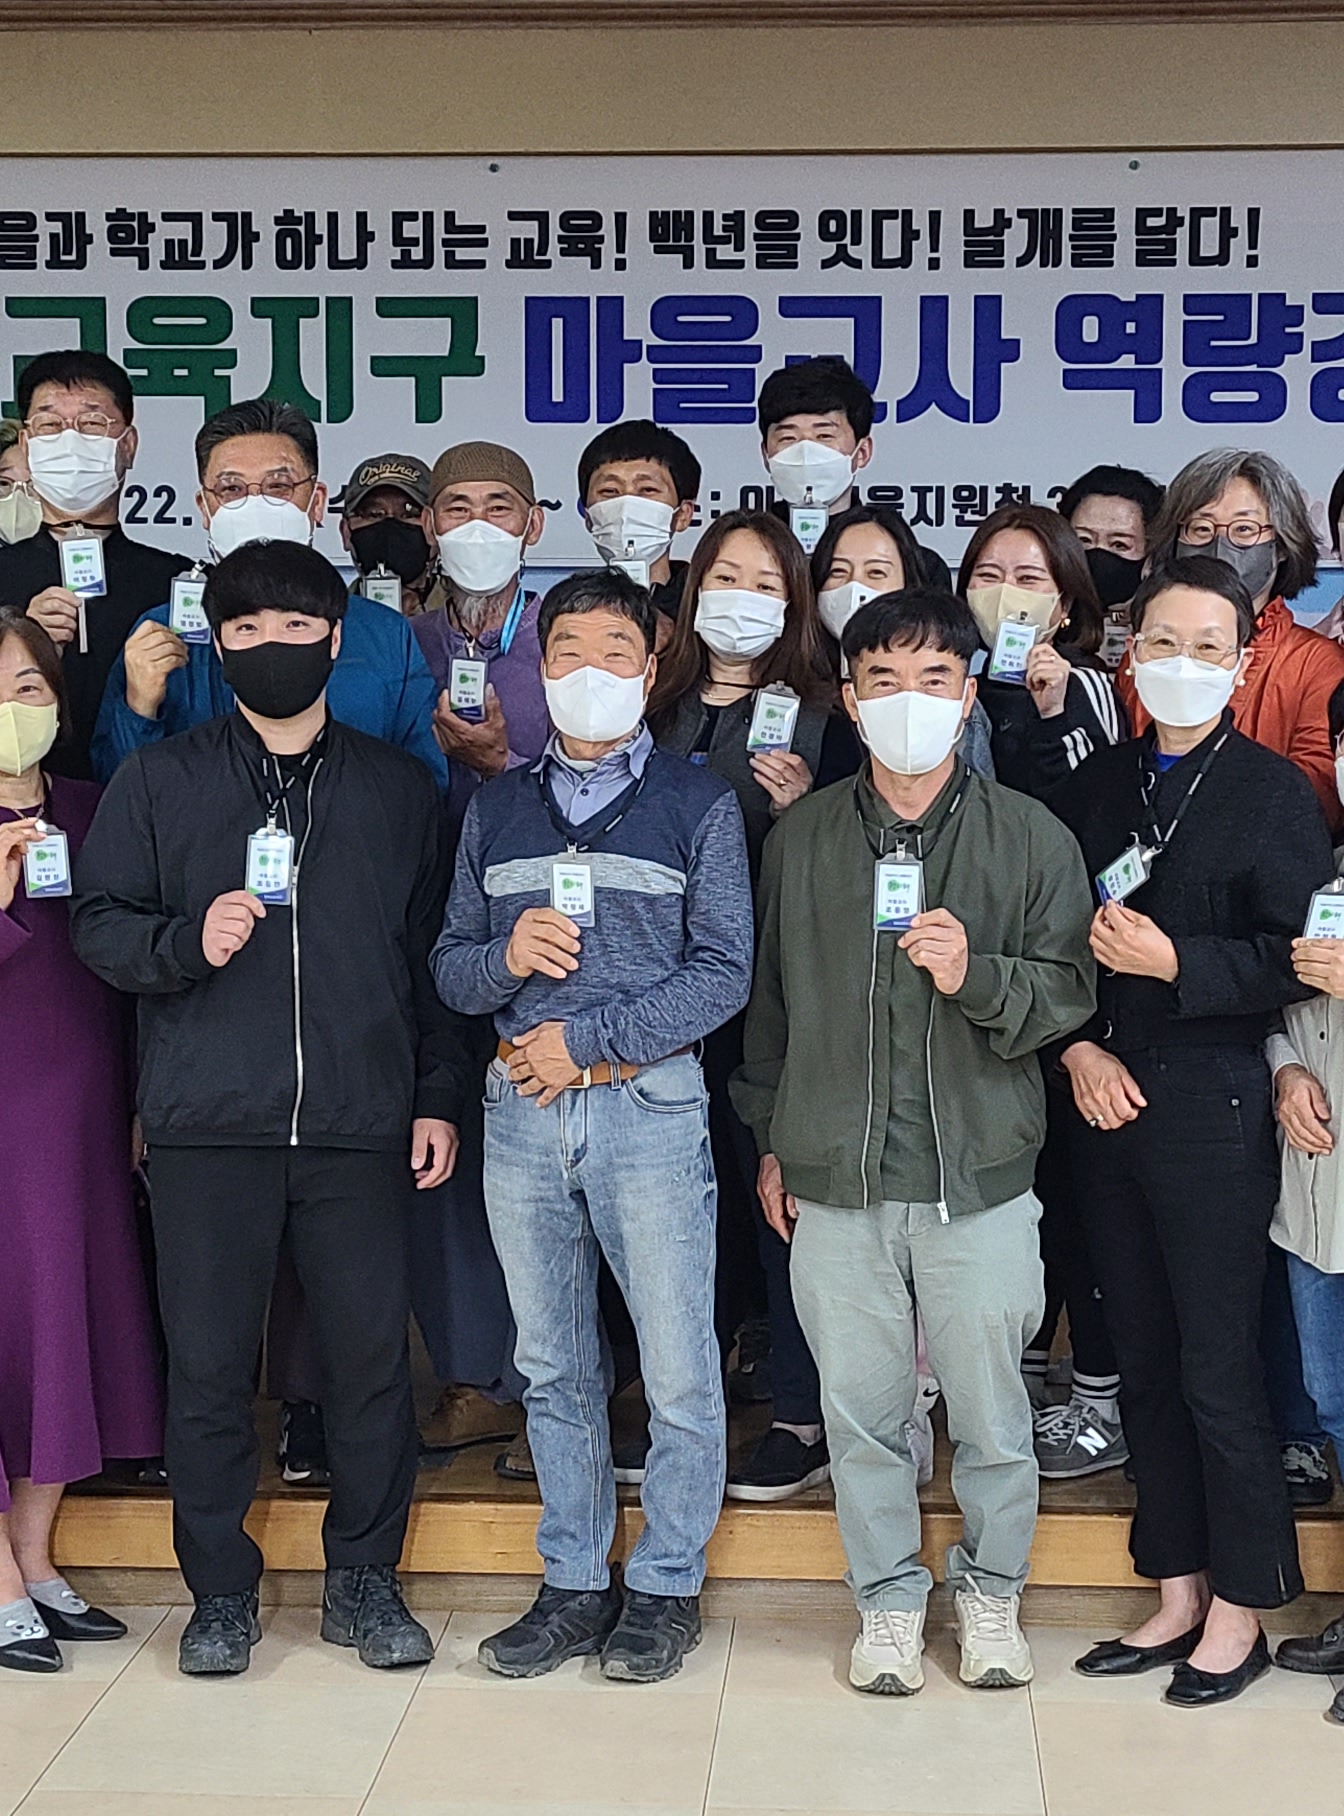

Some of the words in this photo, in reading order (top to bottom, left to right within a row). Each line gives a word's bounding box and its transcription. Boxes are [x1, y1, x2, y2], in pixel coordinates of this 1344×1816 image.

[105, 208, 261, 270] 학교가
[274, 208, 376, 270] 하나
[391, 210, 489, 270] 되는
[505, 210, 628, 271] 교육!
[649, 209, 802, 270] 백년을
[818, 208, 941, 270] 잇다!
[963, 207, 1118, 268] 날개를
[1135, 206, 1261, 268] 달다!
